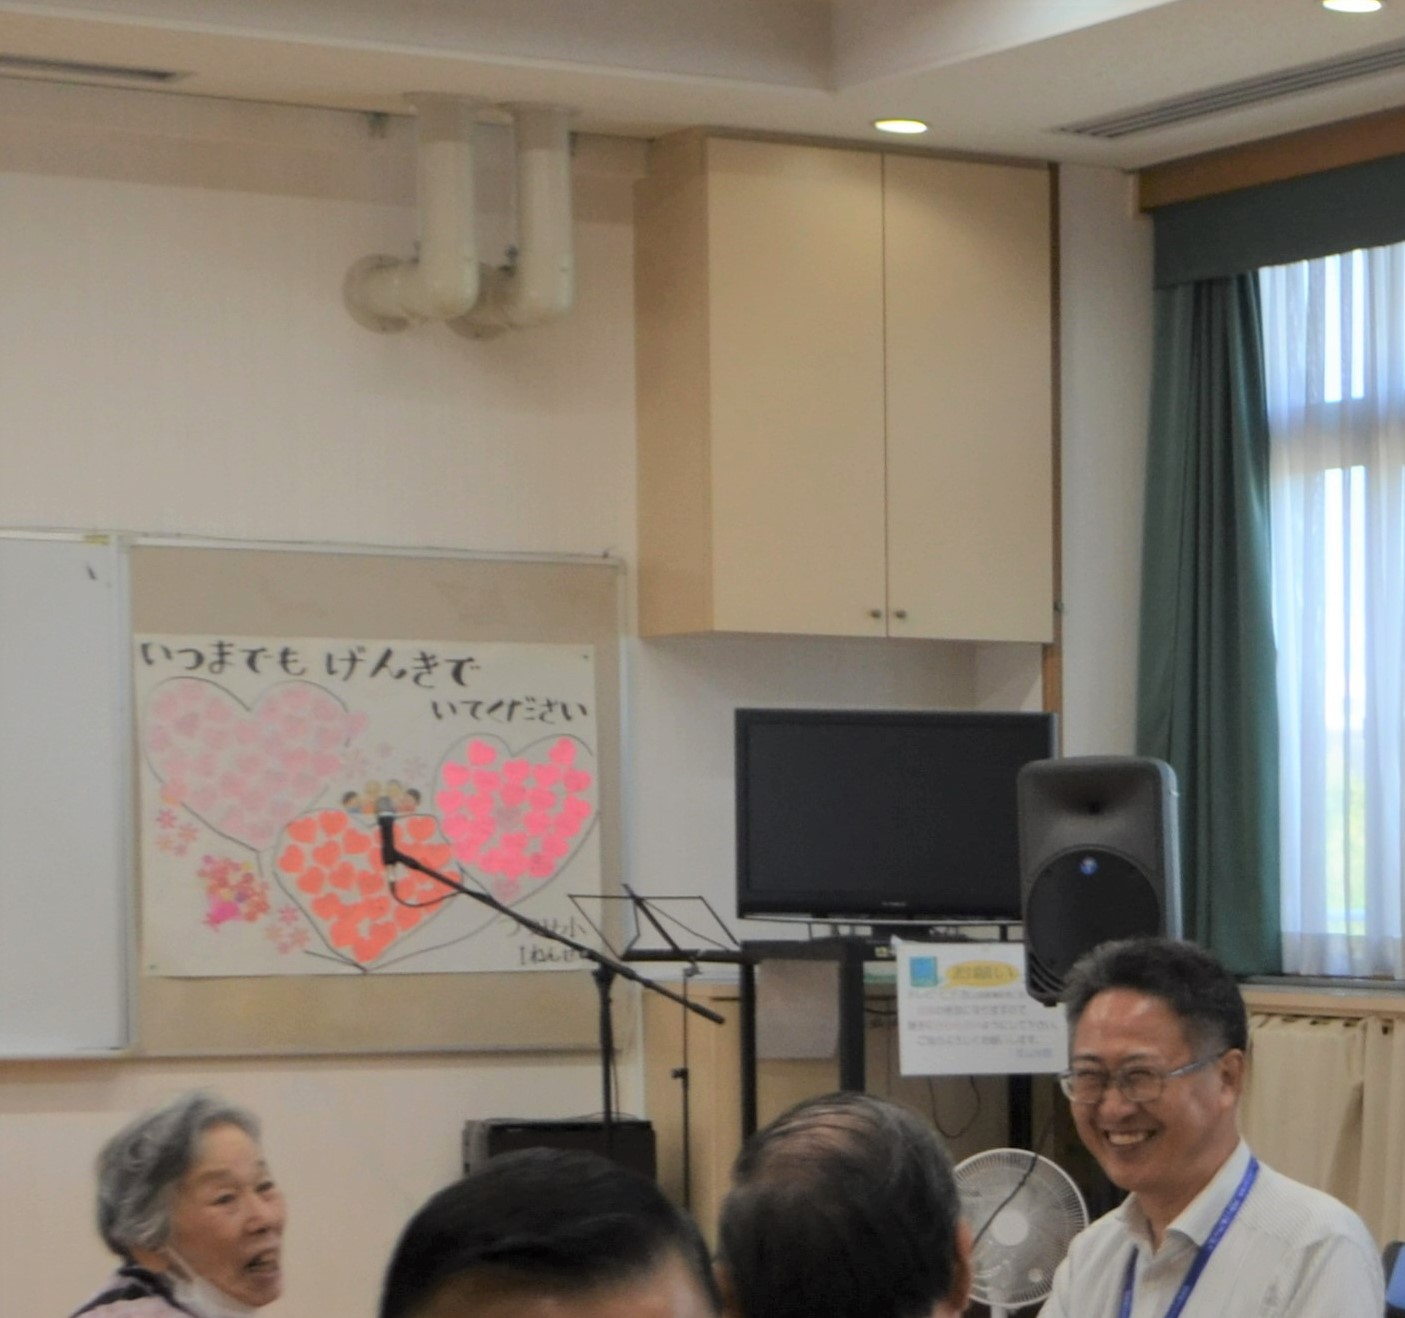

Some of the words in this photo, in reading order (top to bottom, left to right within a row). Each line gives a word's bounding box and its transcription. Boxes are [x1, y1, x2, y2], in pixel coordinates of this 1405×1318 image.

[141, 640, 307, 676] いつまでも
[326, 646, 481, 688] げんきで
[432, 696, 588, 725] いてください
